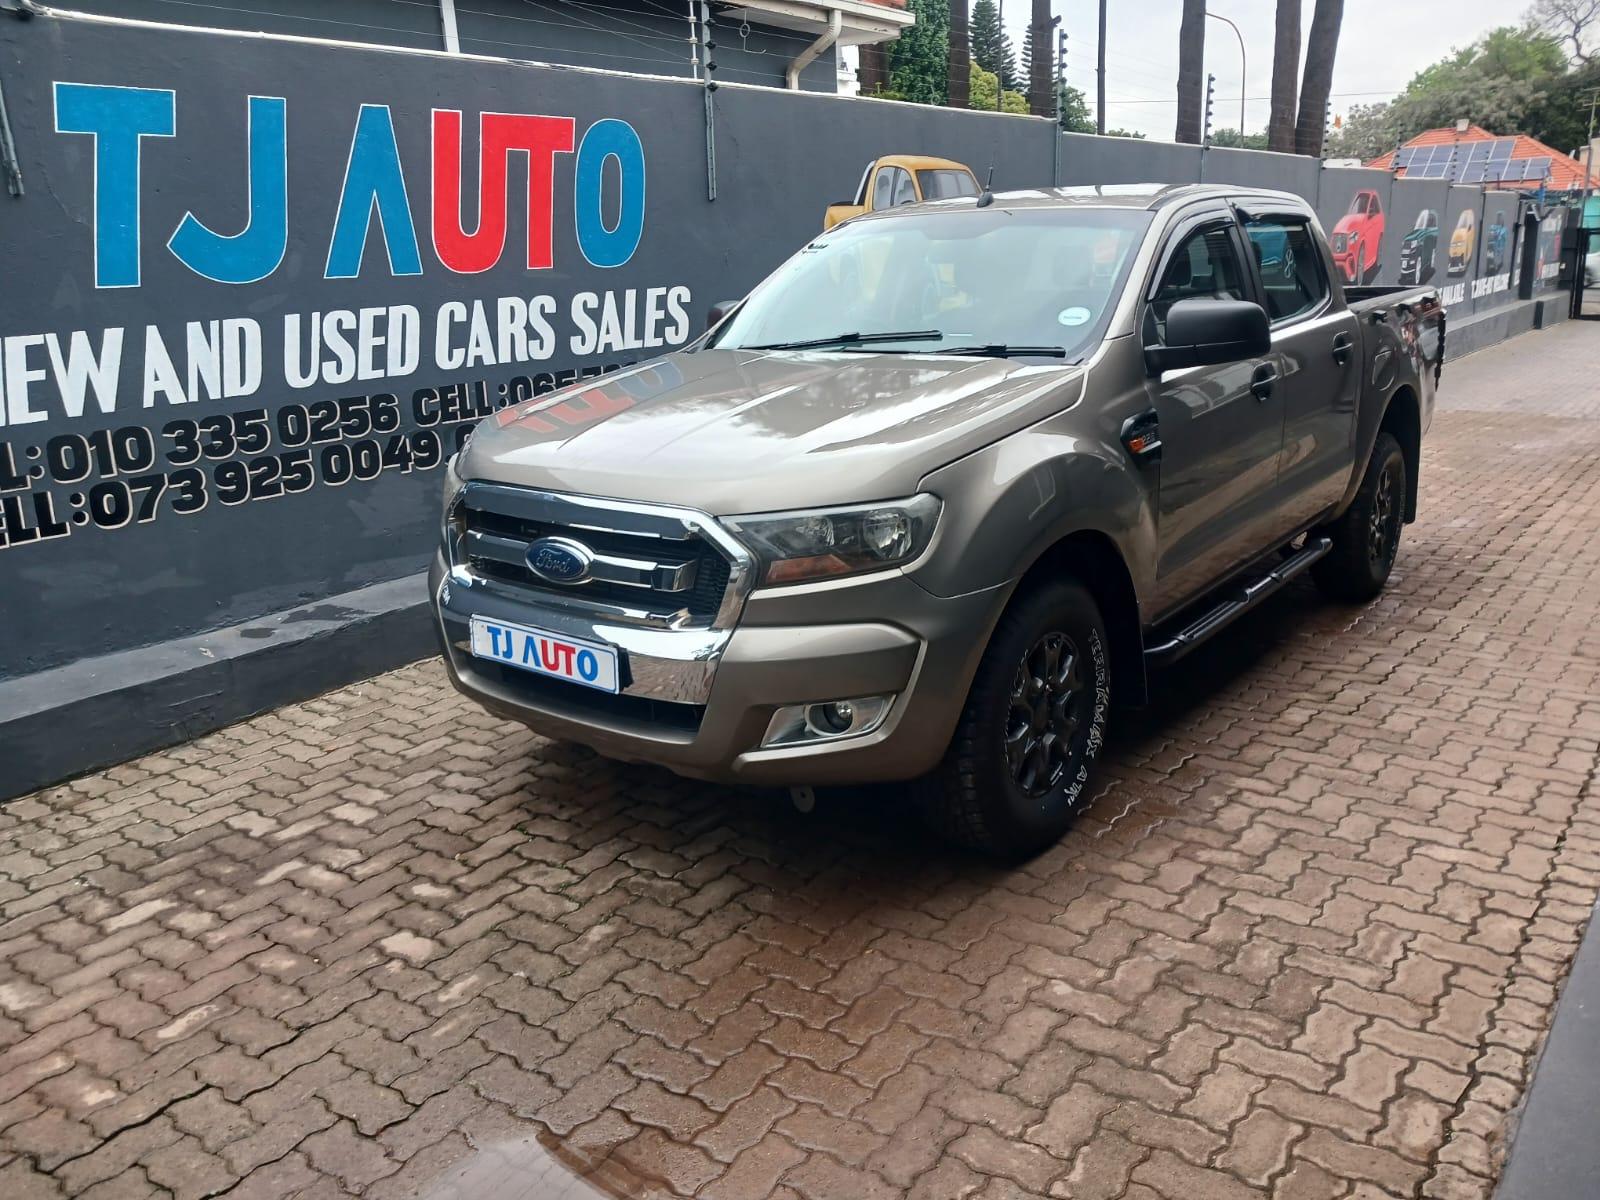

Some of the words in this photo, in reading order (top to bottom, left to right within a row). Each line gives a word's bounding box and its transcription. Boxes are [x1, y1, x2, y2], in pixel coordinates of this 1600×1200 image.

[52, 81, 287, 288] TJ
[324, 103, 646, 279] AUTO
[0, 327, 124, 427] EW
[143, 318, 262, 408] AND
[284, 304, 421, 388] USED
[435, 295, 557, 370] CARS
[570, 286, 692, 355] SALES
[162, 409, 271, 466] 335
[277, 394, 401, 448] 0256
[214, 450, 315, 506] 925
[321, 430, 442, 486] 0049
[535, 548, 570, 574] Ford
[487, 625, 513, 660] TJ
[523, 635, 599, 682] AUTO
